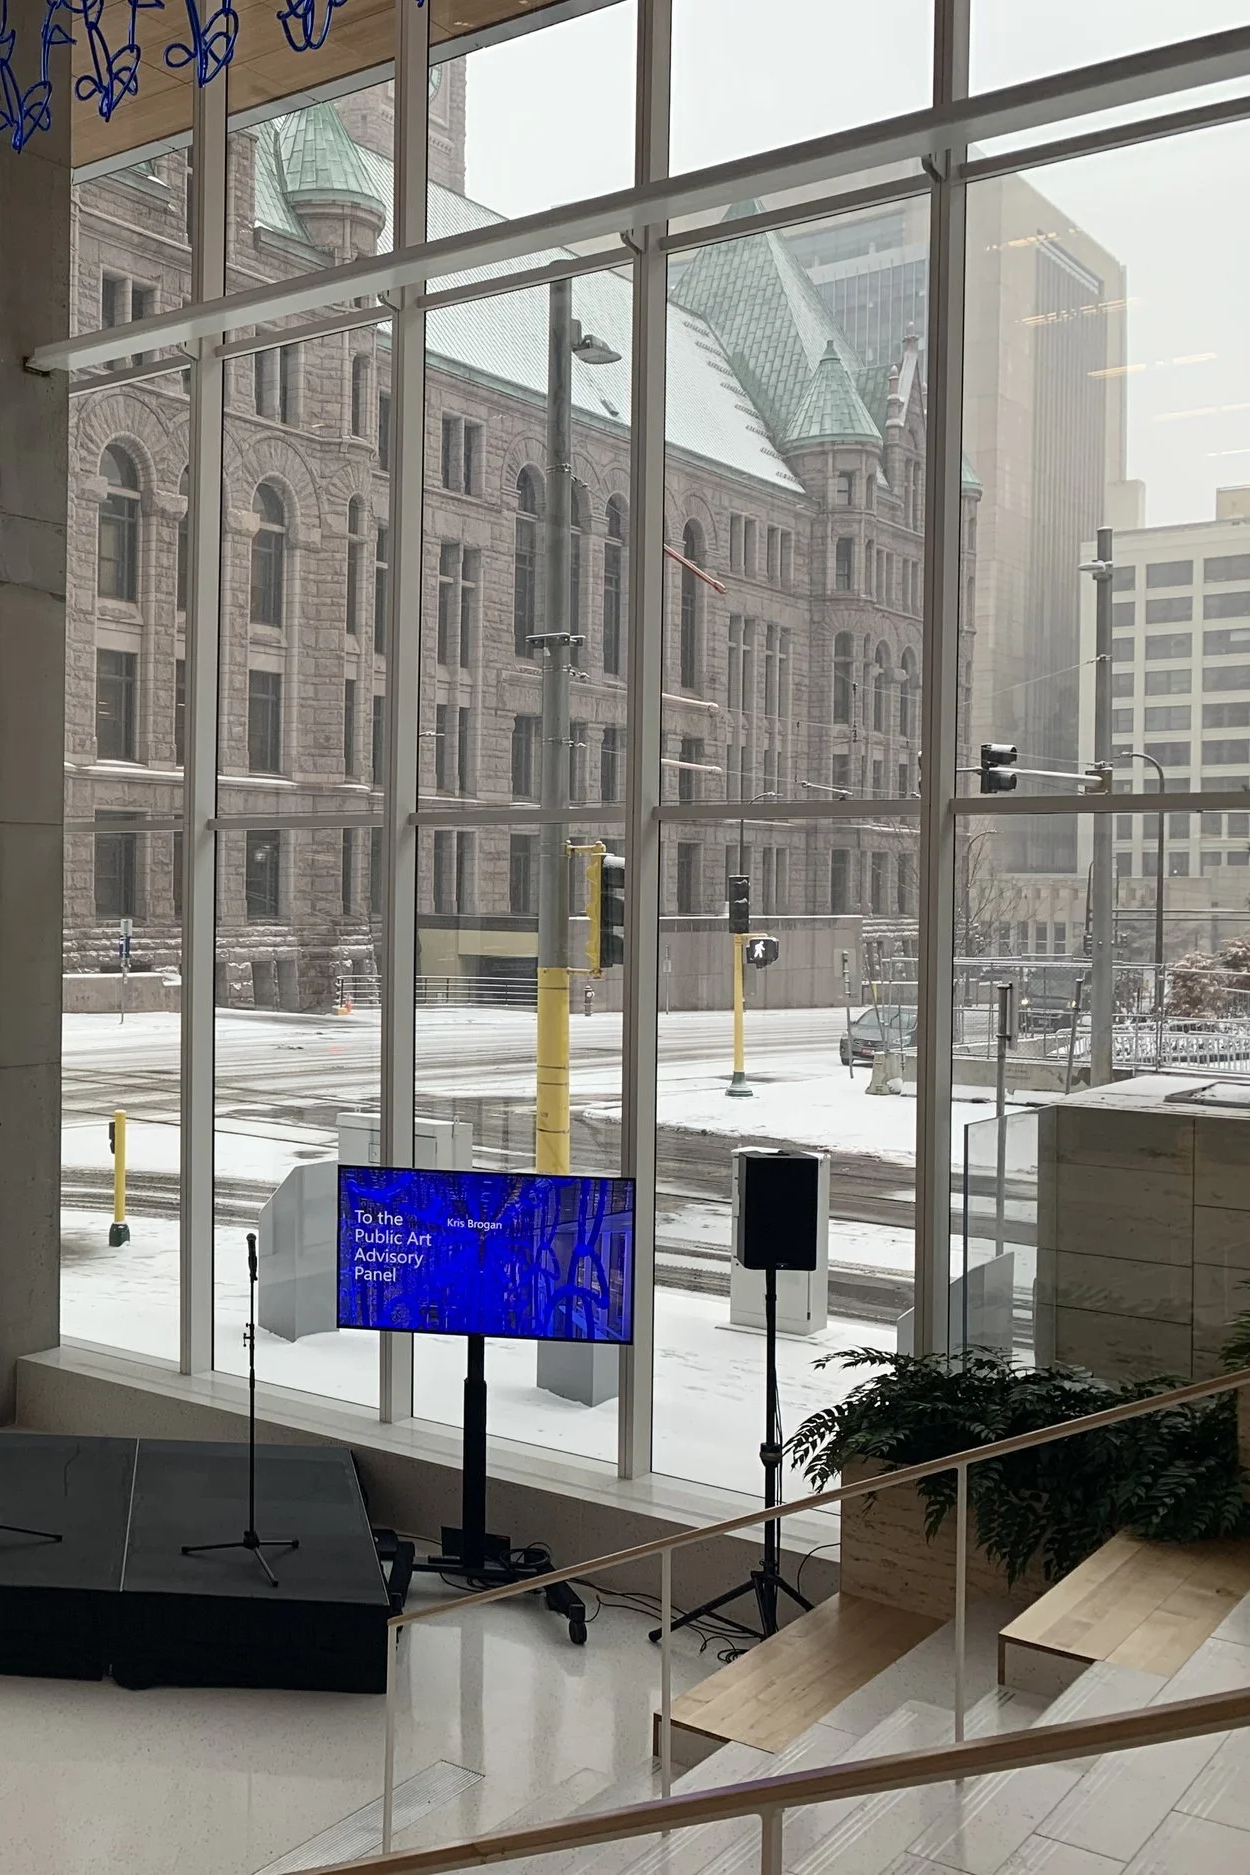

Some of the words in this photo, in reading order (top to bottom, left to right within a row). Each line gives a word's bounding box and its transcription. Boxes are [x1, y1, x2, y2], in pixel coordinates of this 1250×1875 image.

[354, 1209, 373, 1224] To
[377, 1210, 403, 1226] the
[447, 1217, 465, 1228] Kris
[467, 1219, 503, 1232] Brogan
[355, 1228, 403, 1245] Public
[407, 1231, 432, 1247] Art
[354, 1247, 424, 1269] Advisory
[354, 1266, 396, 1282] Panel
